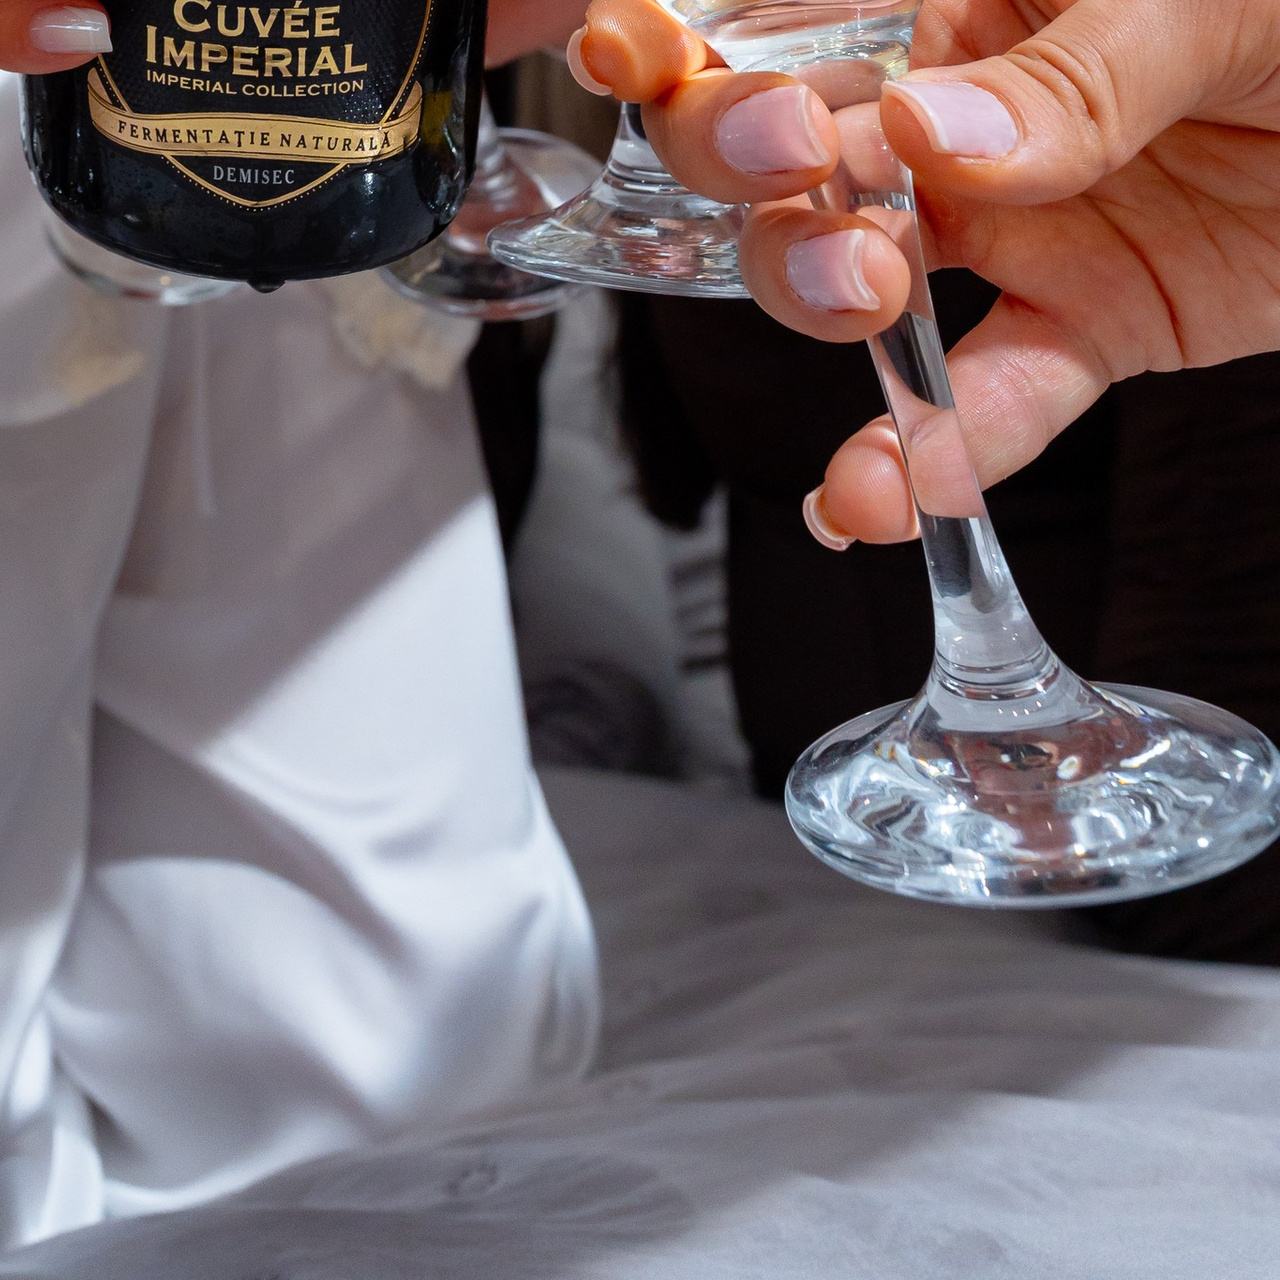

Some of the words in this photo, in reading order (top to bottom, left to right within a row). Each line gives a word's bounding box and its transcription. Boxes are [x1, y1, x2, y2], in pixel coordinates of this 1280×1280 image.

[145, 24, 368, 78] IMPERIAL
[146, 69, 238, 96] IMPERIAL
[242, 78, 364, 98] COLLECTION
[213, 165, 296, 185] DEMISEC
